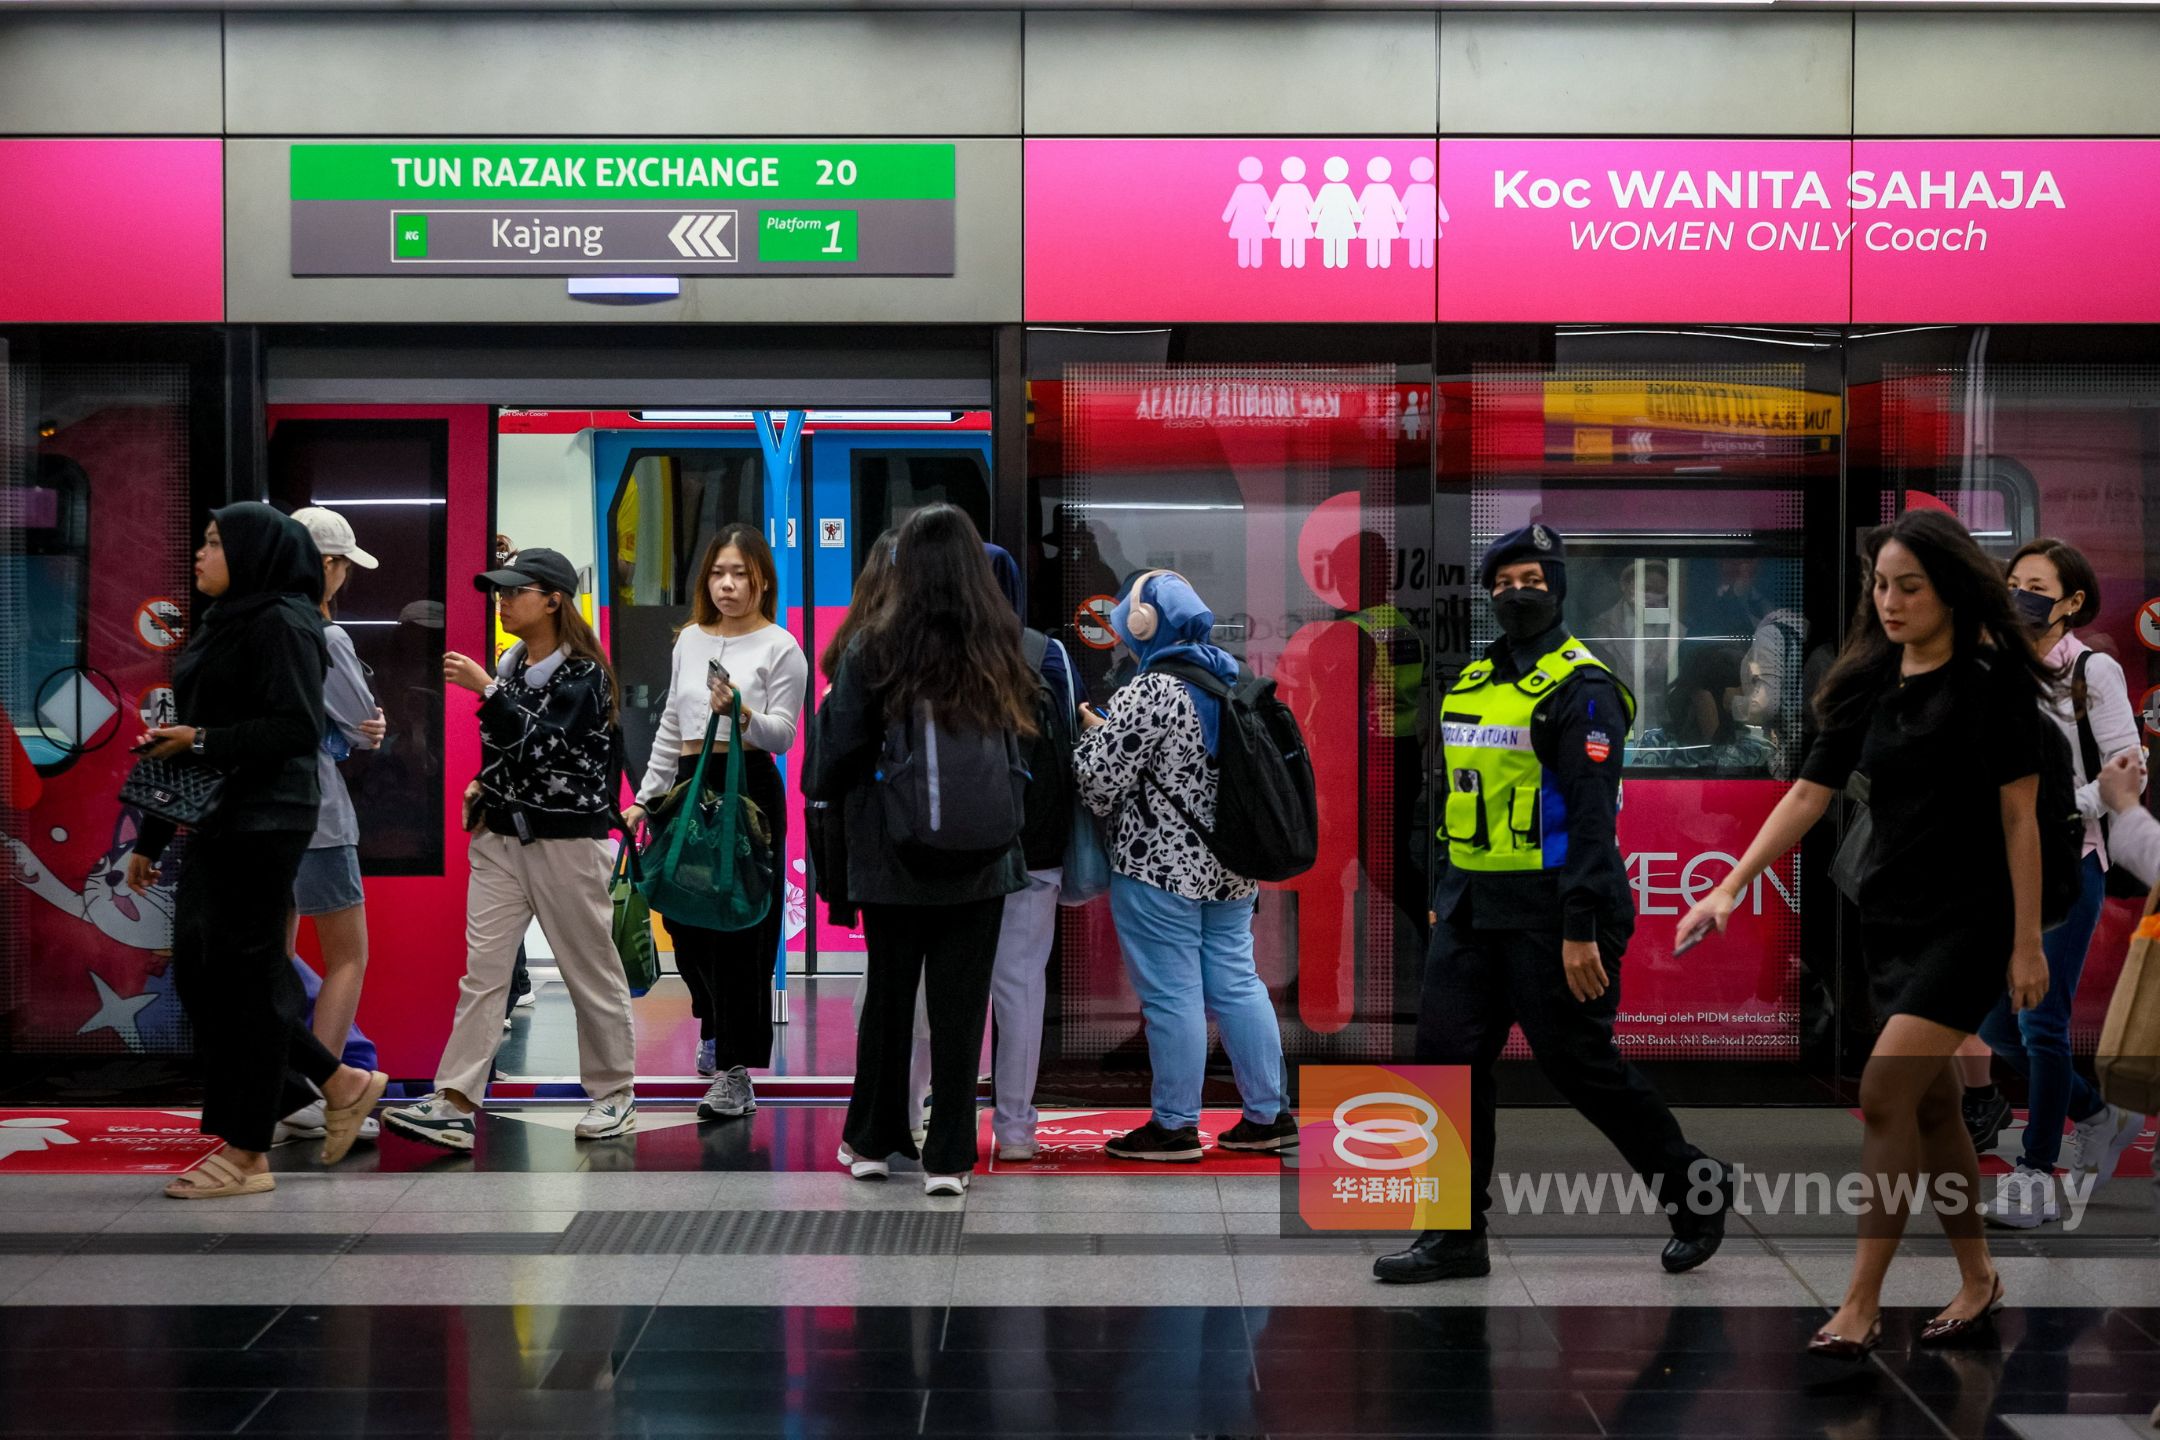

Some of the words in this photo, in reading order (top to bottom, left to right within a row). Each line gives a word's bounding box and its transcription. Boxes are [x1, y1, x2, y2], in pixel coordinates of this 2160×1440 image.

[391, 157, 461, 187] TUN
[472, 157, 586, 187] RAZAK
[596, 157, 779, 187] EXCHANGE
[815, 159, 857, 186] 20
[1494, 169, 1592, 209] Koc
[1608, 169, 1833, 210] WANITA
[1846, 168, 2066, 210] SAHAJA
[492, 217, 604, 257] Kajang
[766, 216, 821, 234] Platform
[821, 220, 843, 253] 1
[1569, 220, 1735, 252] WOMEN
[1746, 220, 1858, 252] ONLY
[1863, 219, 1988, 252] Coach
[1669, 1012, 1695, 1023] oleh
[1697, 1012, 1729, 1023] PIDM
[1731, 1012, 1775, 1023] setakat
